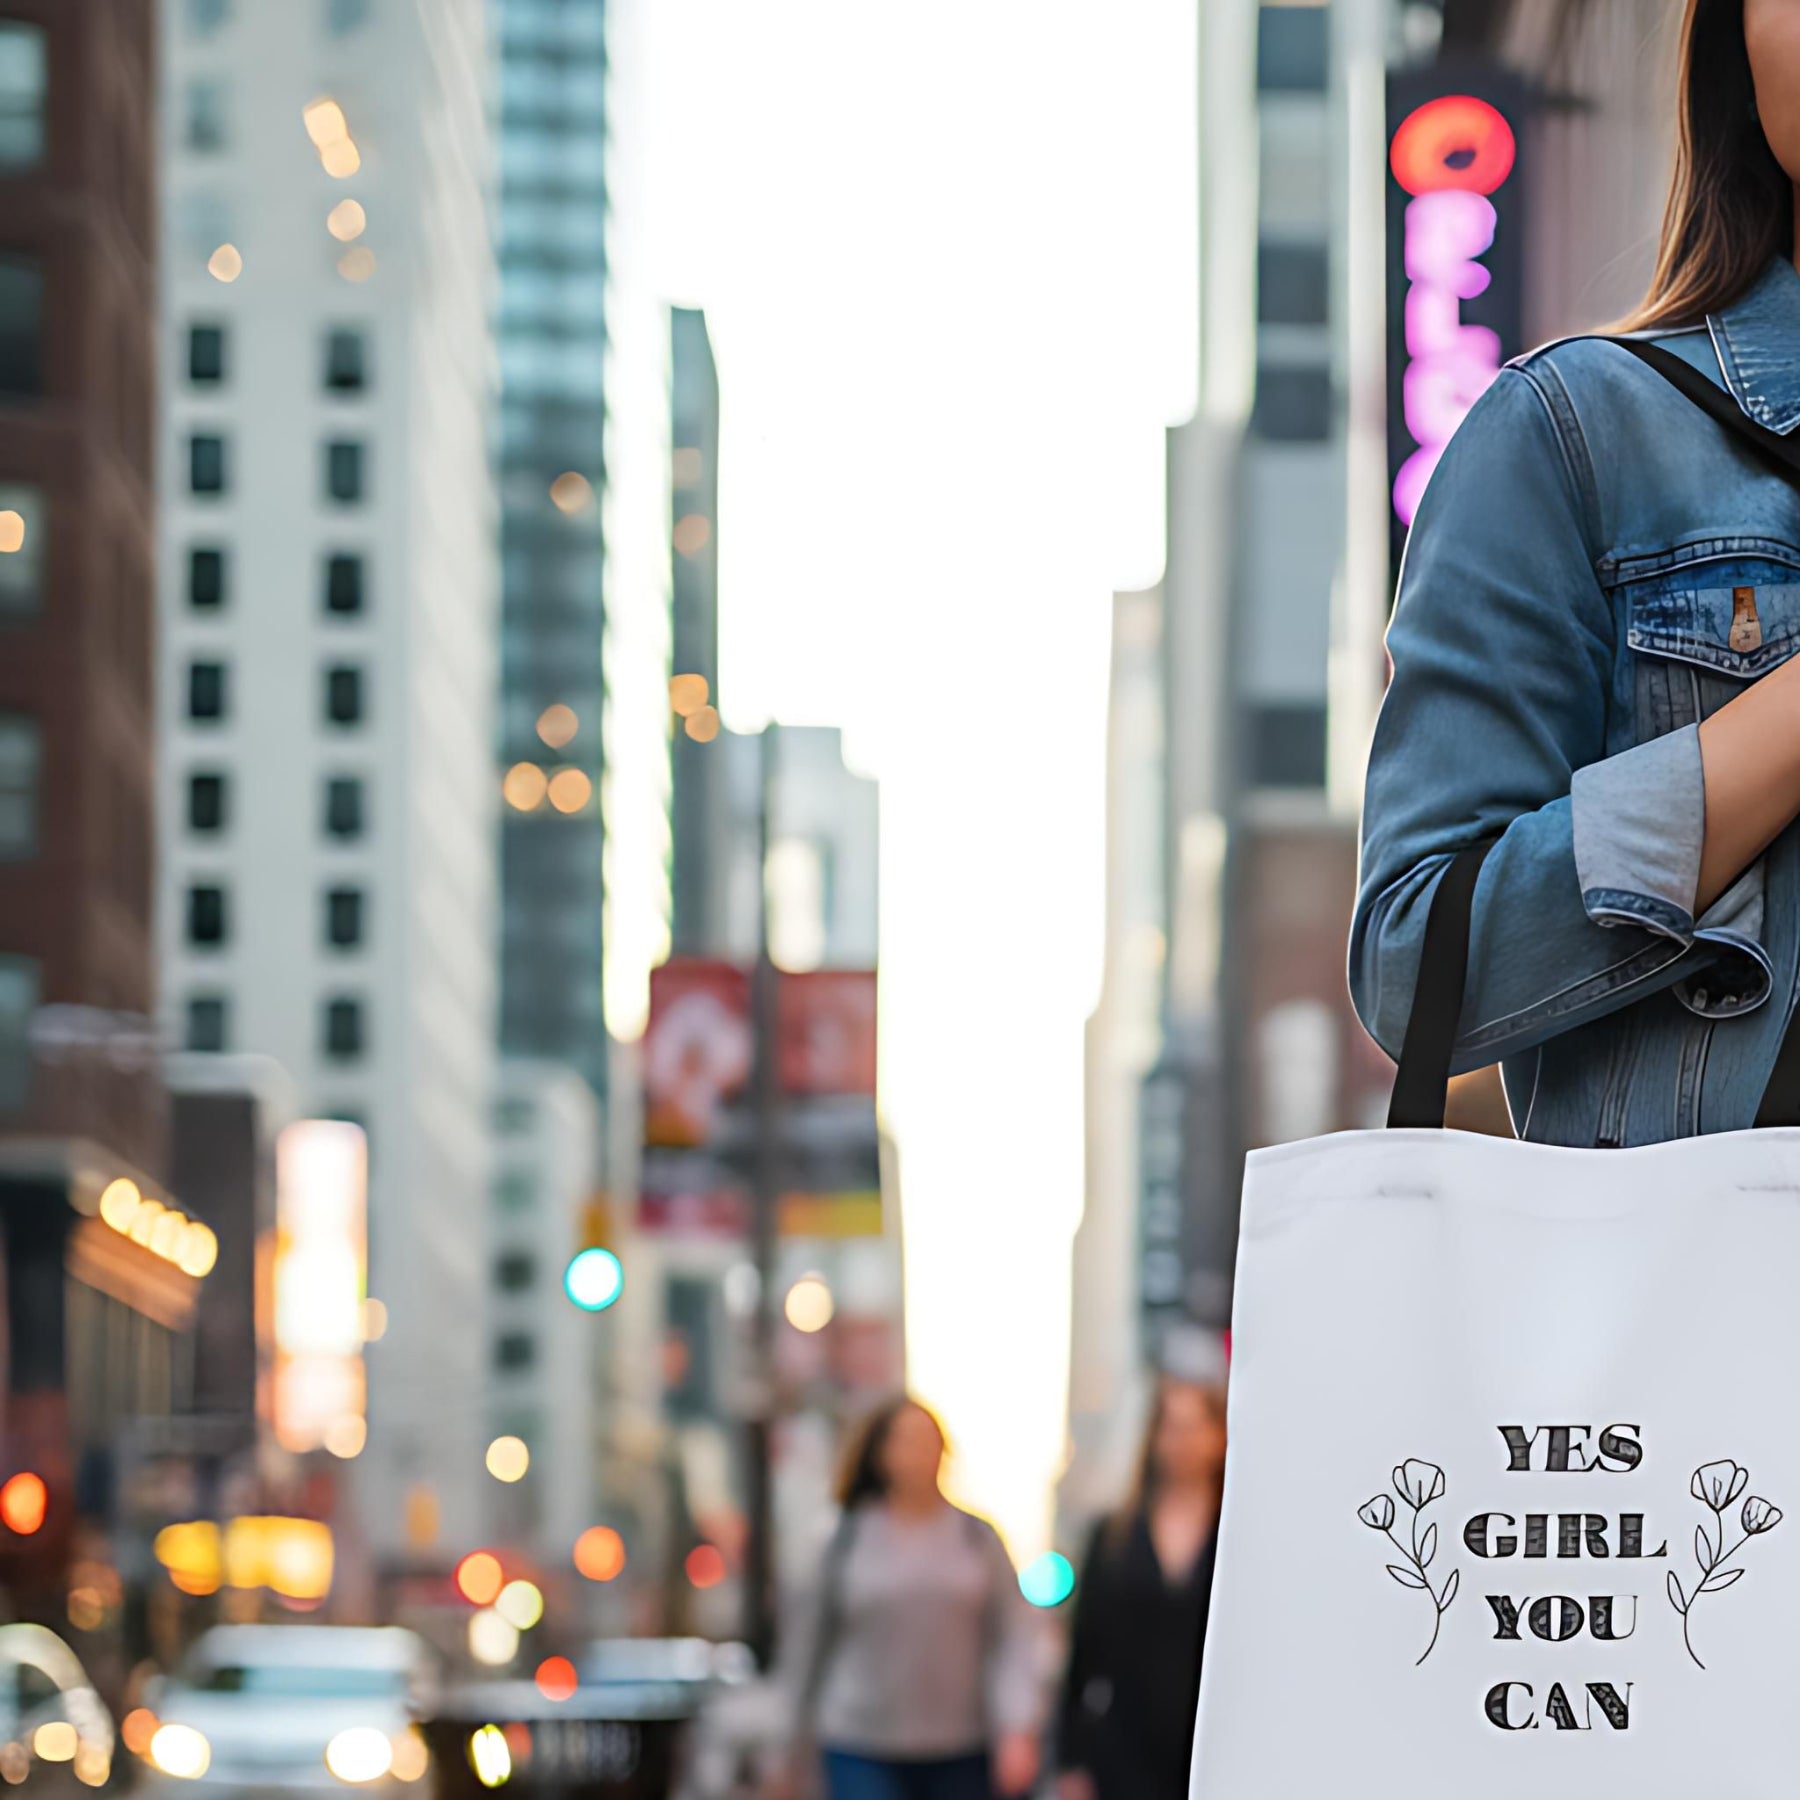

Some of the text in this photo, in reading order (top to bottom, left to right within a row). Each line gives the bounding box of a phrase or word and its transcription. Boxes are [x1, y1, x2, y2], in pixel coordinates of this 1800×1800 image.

[1496, 1423, 1644, 1474] YES
[1463, 1512, 1668, 1559] GIRL
[1485, 1595, 1639, 1642] YOU
[1484, 1681, 1635, 1730] CAN
